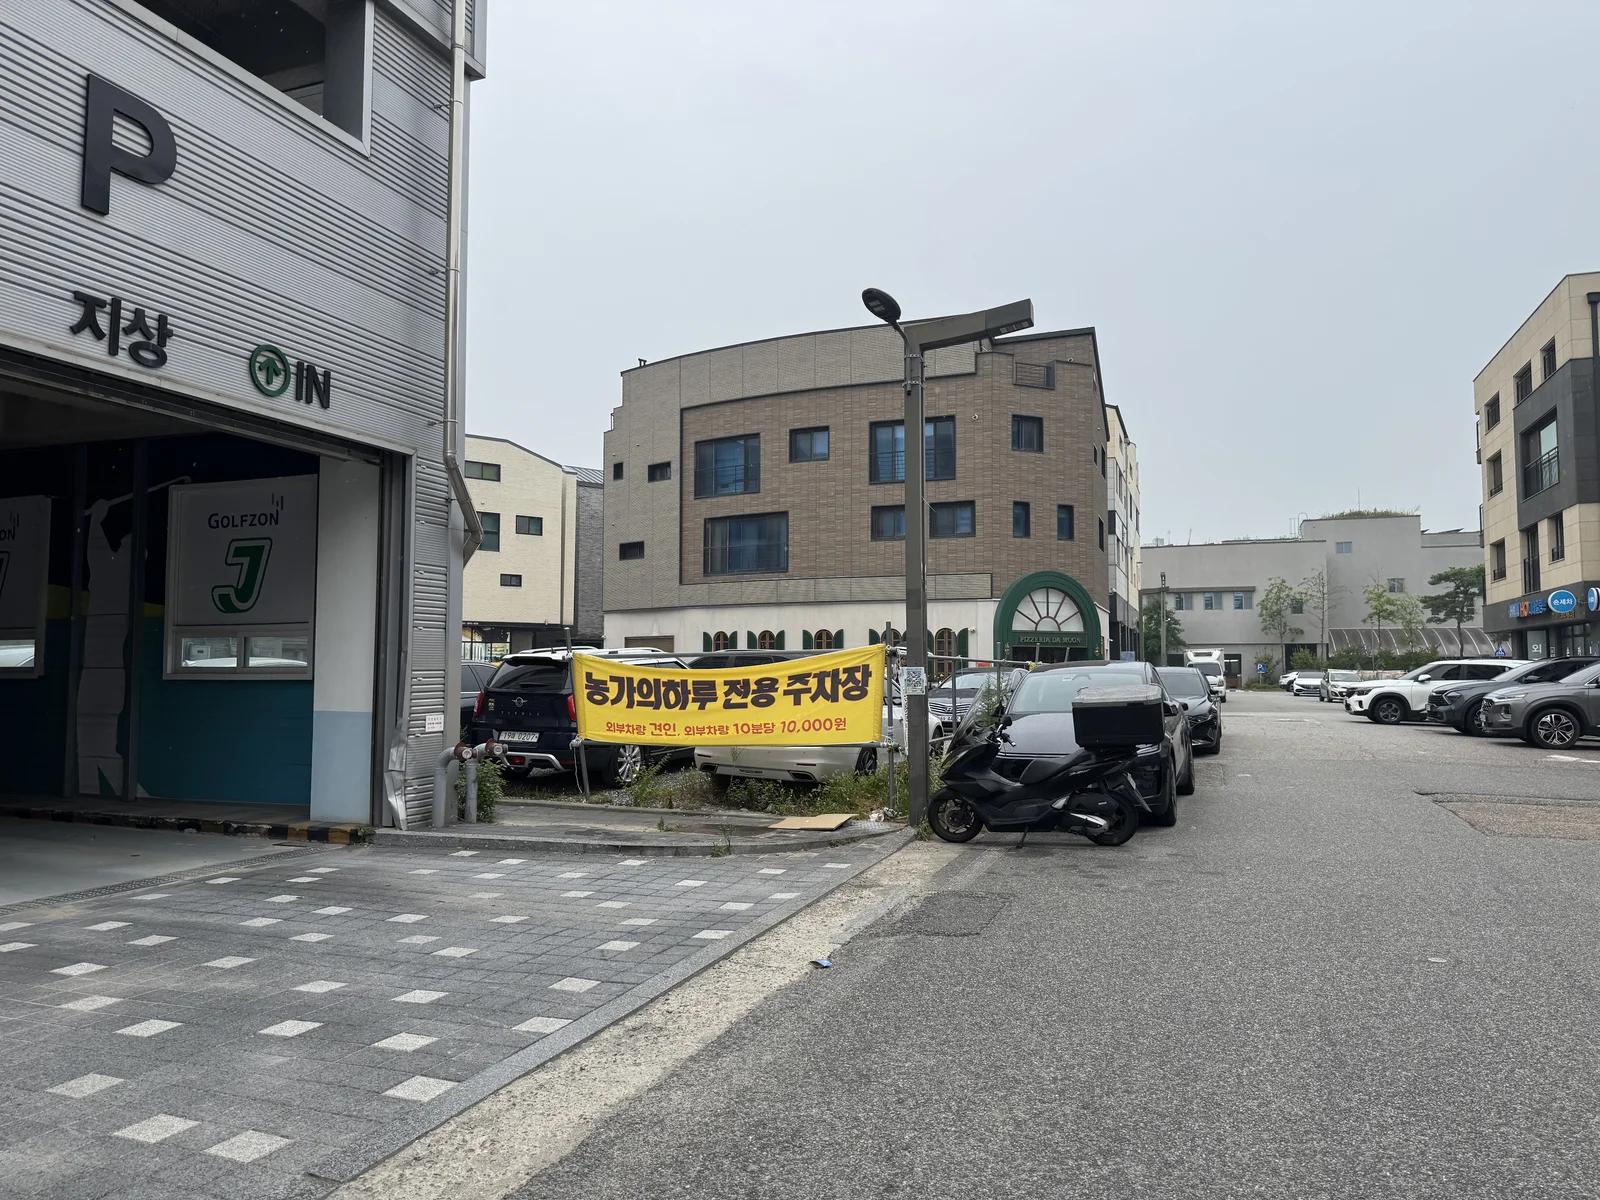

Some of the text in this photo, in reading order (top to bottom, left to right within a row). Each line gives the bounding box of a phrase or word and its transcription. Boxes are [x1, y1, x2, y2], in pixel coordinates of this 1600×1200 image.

[81, 73, 178, 216] P
[69, 290, 174, 368] 지상
[295, 361, 332, 410] IN
[208, 509, 279, 529] GOLFZON
[1020, 636, 1051, 644] PIZZERIA
[585, 664, 872, 710] 농가의하루 전용 주차장
[606, 721, 646, 735] 외부차량
[684, 725, 729, 736] 외부차량
[733, 722, 776, 735] 10분당
